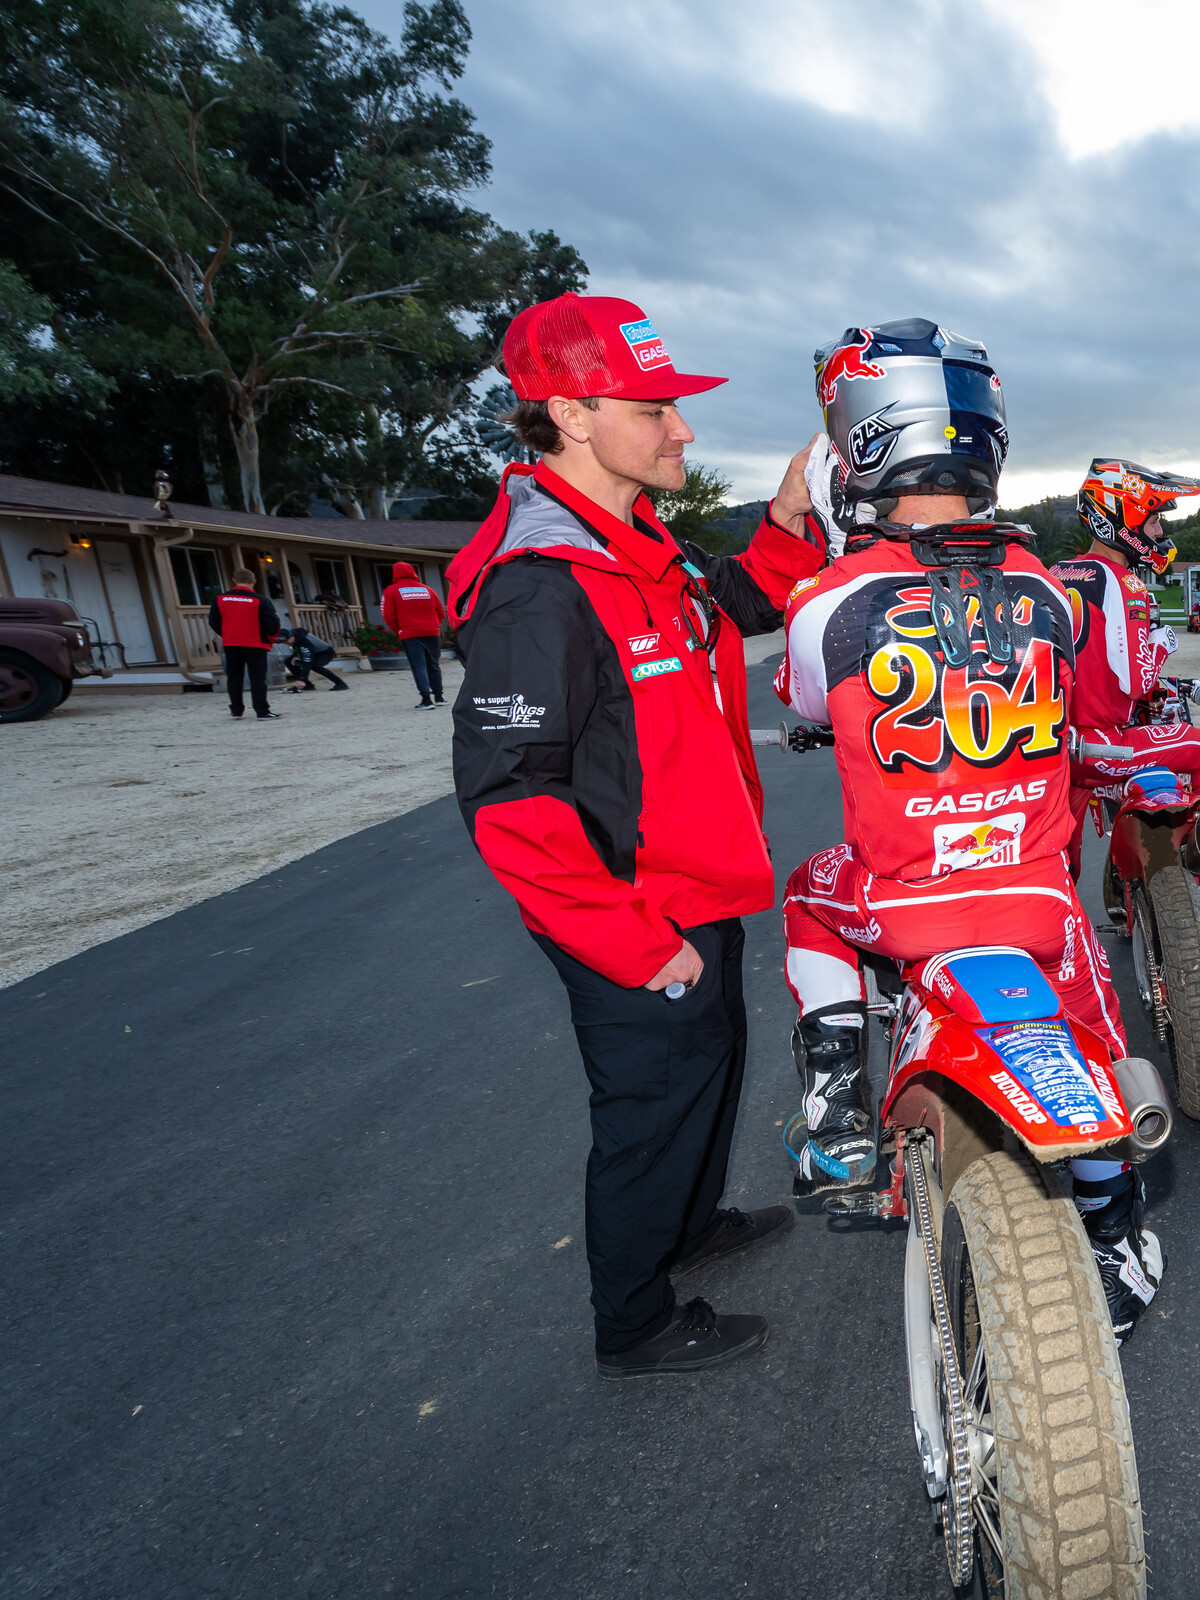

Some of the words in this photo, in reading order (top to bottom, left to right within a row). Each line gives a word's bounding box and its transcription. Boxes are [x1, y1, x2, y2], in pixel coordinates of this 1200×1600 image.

[865, 636, 1066, 773] 264
[904, 780, 1048, 819] GASGAS
[839, 916, 882, 945] GASGAS
[934, 968, 957, 1001] GASGAS
[989, 1070, 1048, 1125] DUNLOP
[1087, 1058, 1124, 1117] DUNLOP
